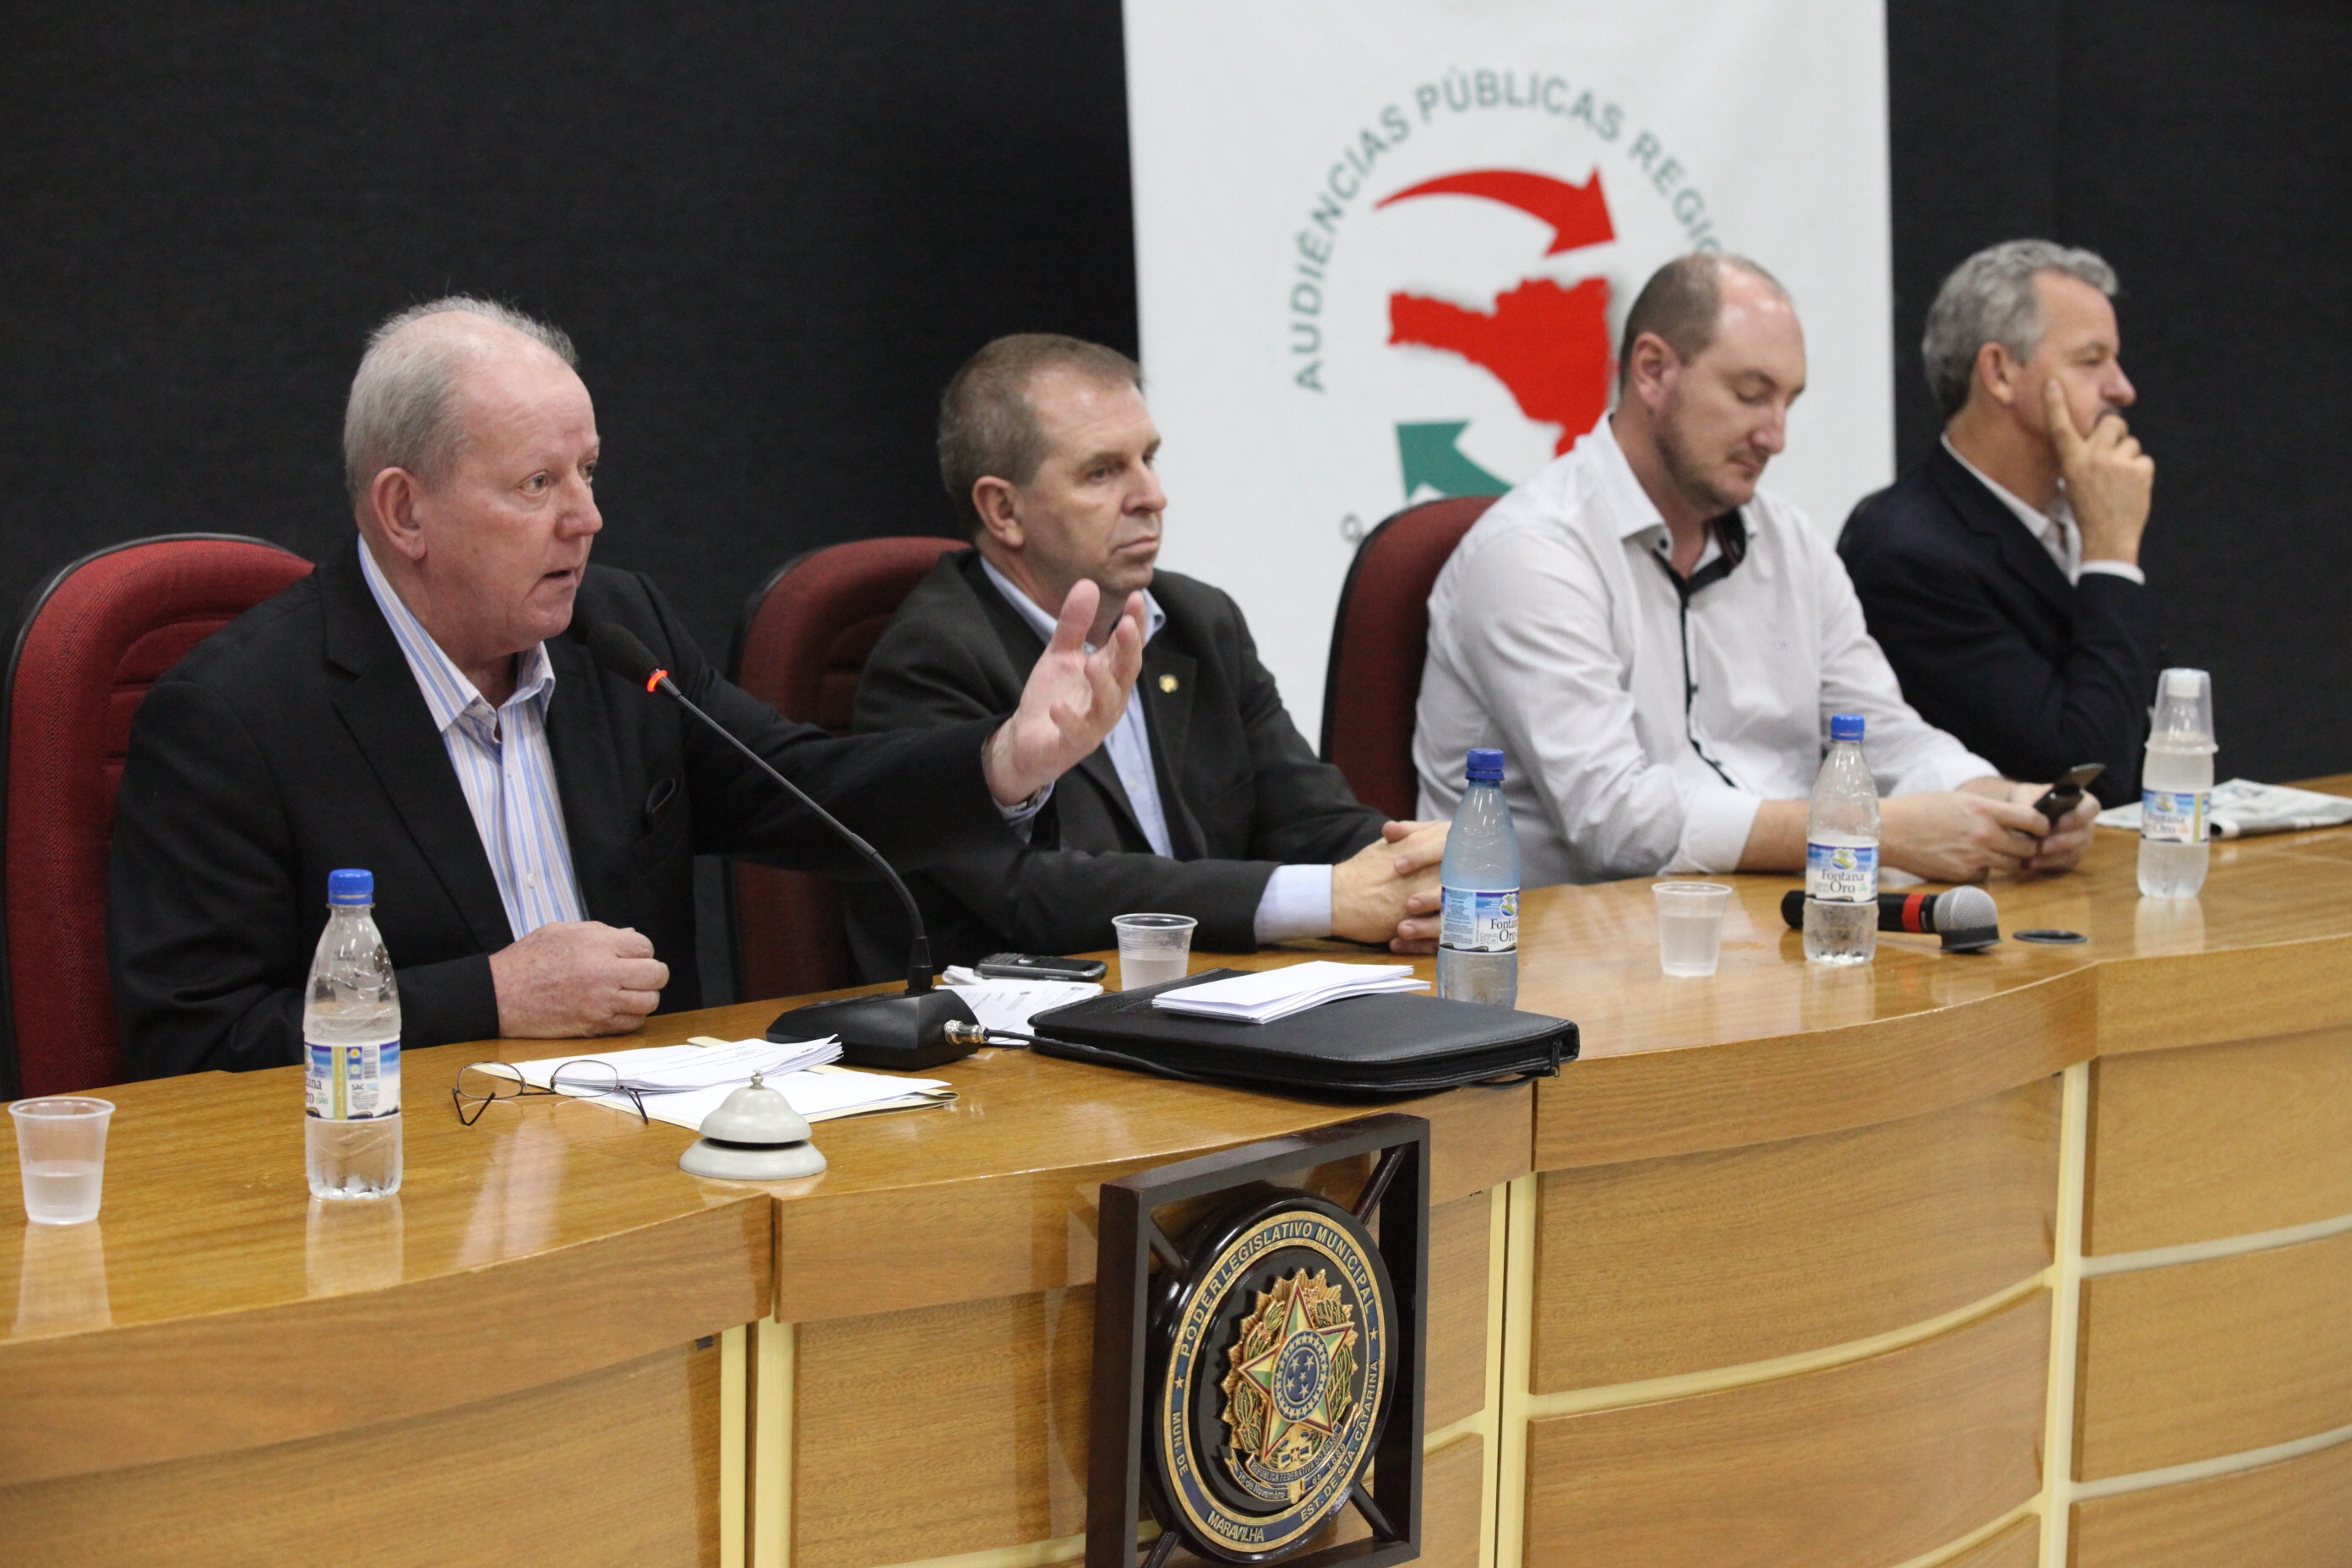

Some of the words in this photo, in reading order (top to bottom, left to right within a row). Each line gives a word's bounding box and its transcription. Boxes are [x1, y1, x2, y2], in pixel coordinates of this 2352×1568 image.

[1290, 104, 1411, 395] AUDIÊNCIAS
[1415, 66, 1625, 142] PÚBLICAS
[1821, 869, 1865, 881] Fontana
[1830, 880, 1855, 893] Oro
[1499, 929, 1516, 942] Oro
[1179, 1277, 1222, 1358] PODER
[1220, 1222, 1312, 1281] LEGISLATIVO
[1315, 1226, 1375, 1314] MUNICIPAL
[1279, 1463, 1315, 1483] FEDERATIVA
[1313, 1455, 1323, 1466] DO
[1321, 1429, 1342, 1455] BRASIL
[1300, 1499, 1324, 1522] EST.
[1324, 1478, 1340, 1497] DE
[1337, 1445, 1358, 1477] STA.
[1354, 1359, 1379, 1441] CATARINA
[1176, 1453, 1189, 1477] DE
[1312, 1474, 1322, 1484] de
[1326, 1443, 1346, 1469] 1889
[1238, 1472, 1245, 1483] 15
[1245, 1478, 1254, 1489] de
[1253, 1484, 1285, 1500] Novembro
[1206, 1510, 1265, 1542] MARAVILHA
